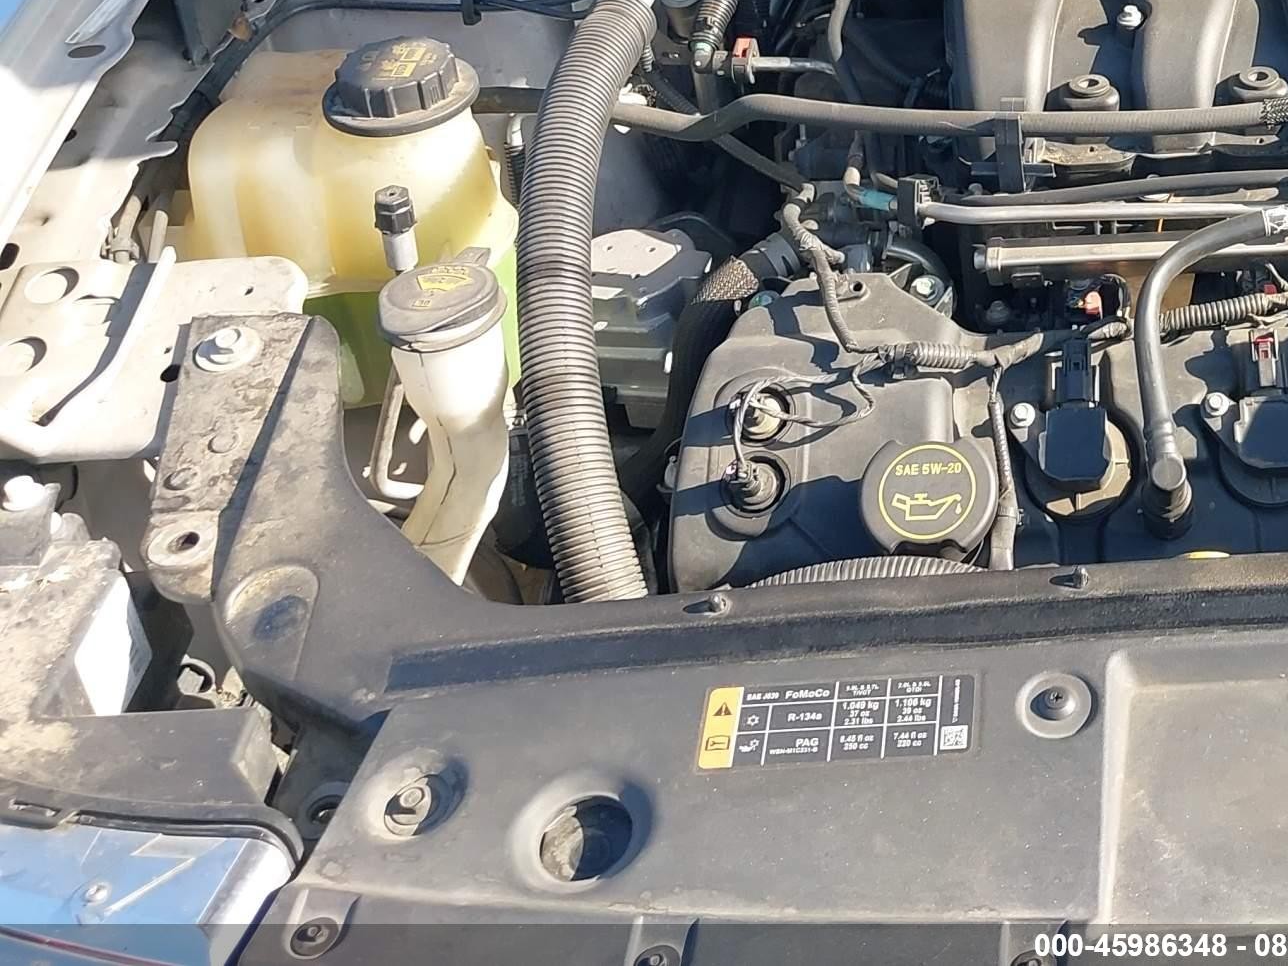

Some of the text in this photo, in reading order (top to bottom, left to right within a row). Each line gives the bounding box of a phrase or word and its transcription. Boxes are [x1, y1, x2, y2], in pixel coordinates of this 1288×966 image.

[895, 462, 962, 476] SAE 5W-20
[785, 688, 830, 700] FoMoCo
[867, 701, 880, 710] kg
[920, 697, 932, 707] kg
[787, 712, 823, 722] R-134a
[849, 710, 859, 718] 37
[914, 714, 927, 722] lbs
[861, 717, 874, 725] lbs
[795, 737, 819, 747] PAG
